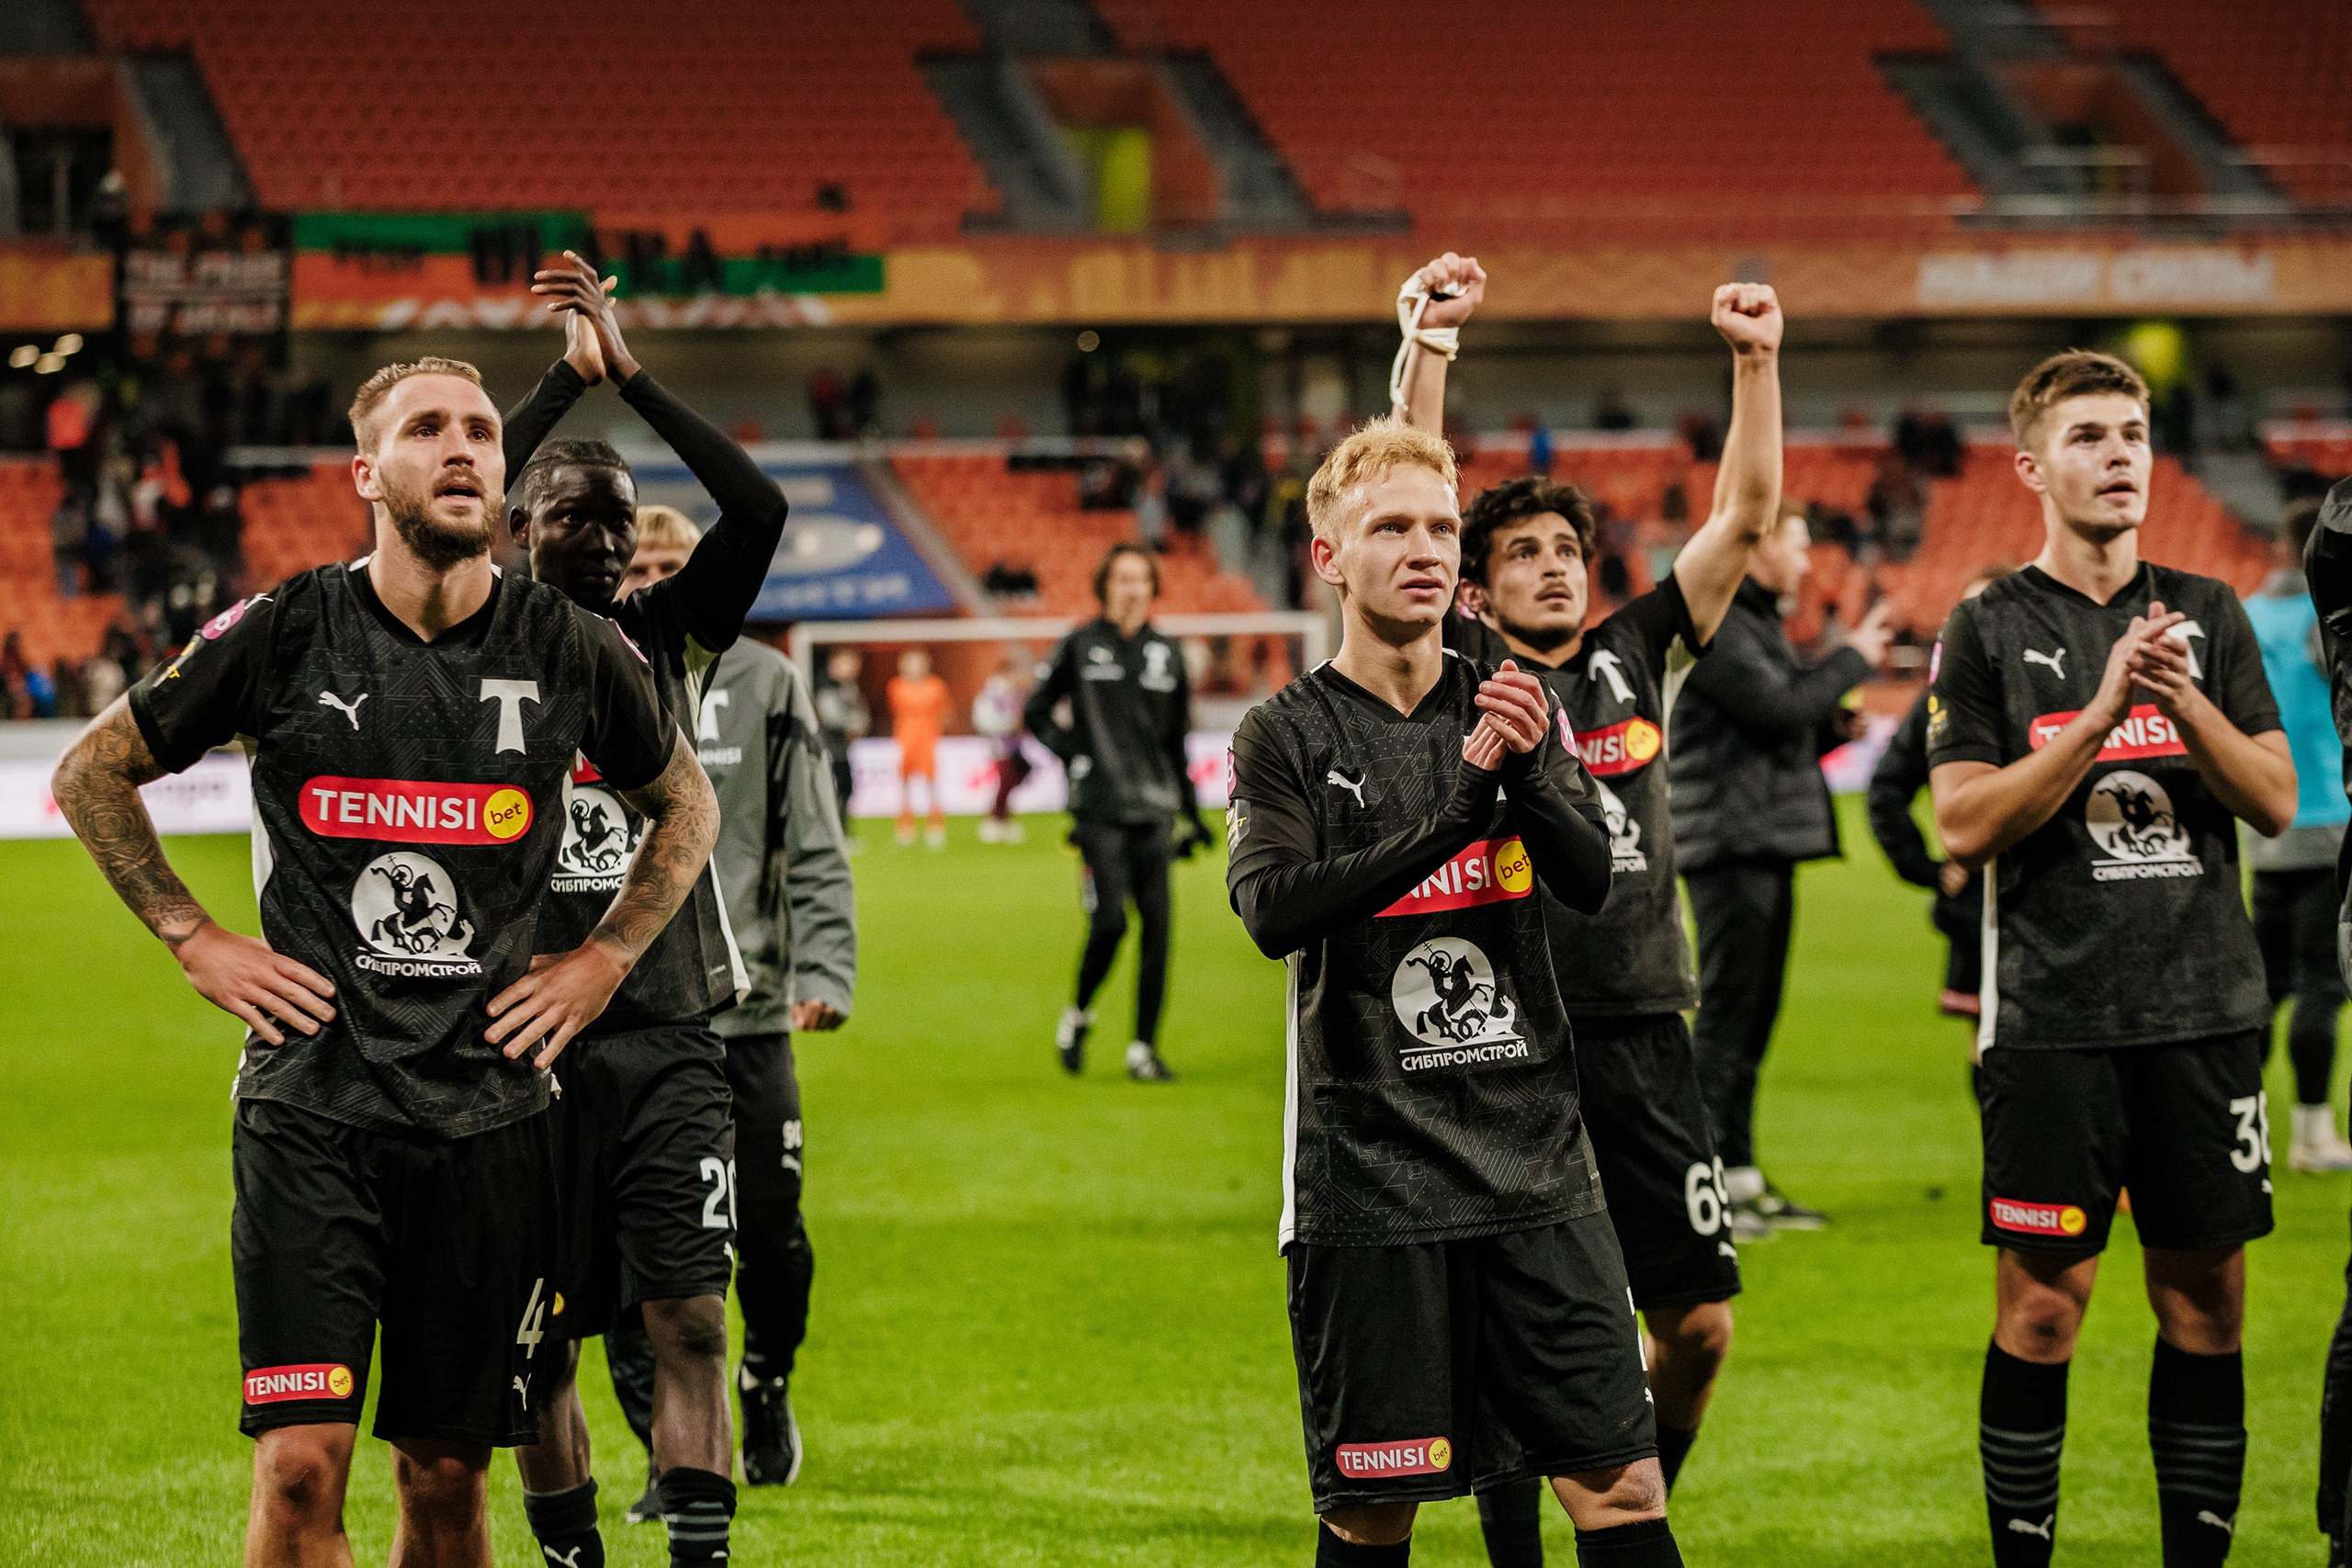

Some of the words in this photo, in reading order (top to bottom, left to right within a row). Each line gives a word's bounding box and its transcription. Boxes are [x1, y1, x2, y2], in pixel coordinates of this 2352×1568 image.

[2036, 716, 2178, 749] TNISI
[1577, 733, 1625, 765] NISI
[312, 788, 476, 830] TENNISI
[490, 802, 522, 826] bet
[550, 876, 624, 893] СИБПРОМС
[1410, 856, 1490, 898] NISI
[1499, 853, 1530, 880] bet
[1401, 1040, 1529, 1071] СИБПРОМСТРОЙ
[1993, 1201, 2058, 1228] TENNISI
[516, 1278, 545, 1359] 4
[247, 1371, 325, 1396] TENNISI
[333, 1375, 349, 1388] bet
[1340, 1447, 1424, 1471] TENNISI
[1432, 1446, 1448, 1461] bet
